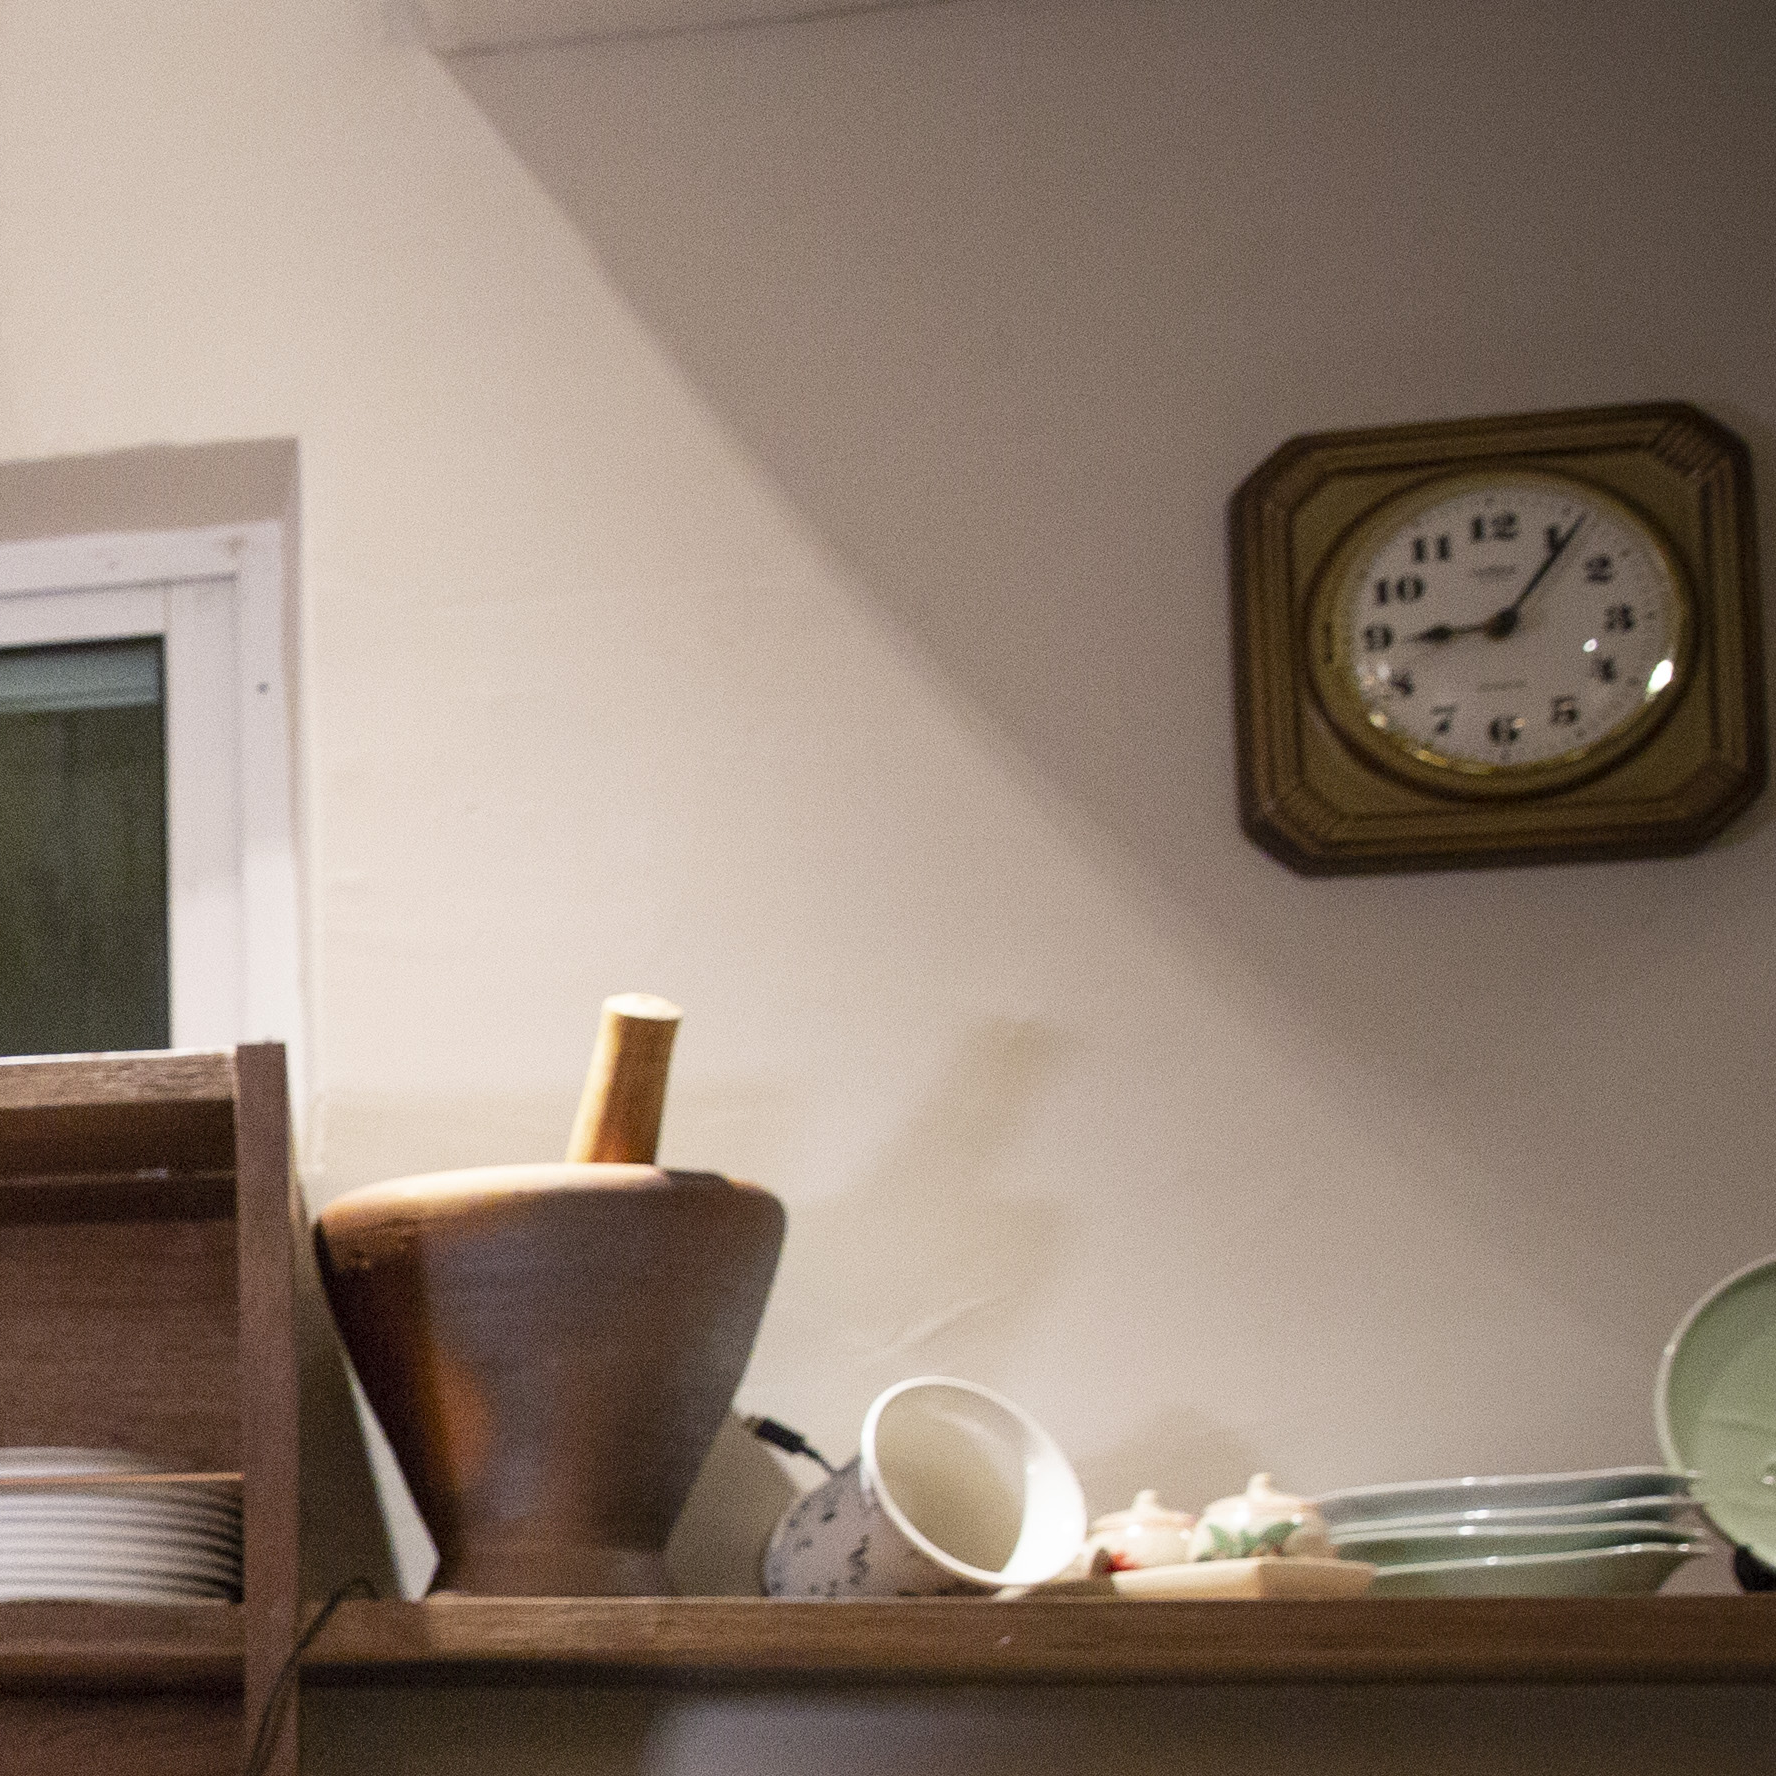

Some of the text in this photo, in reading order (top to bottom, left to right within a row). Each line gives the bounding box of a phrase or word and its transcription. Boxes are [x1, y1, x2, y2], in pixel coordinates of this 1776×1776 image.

[1469, 512, 1519, 544] 12
[1412, 534, 1452, 564] 11
[1375, 575, 1426, 606] 10
